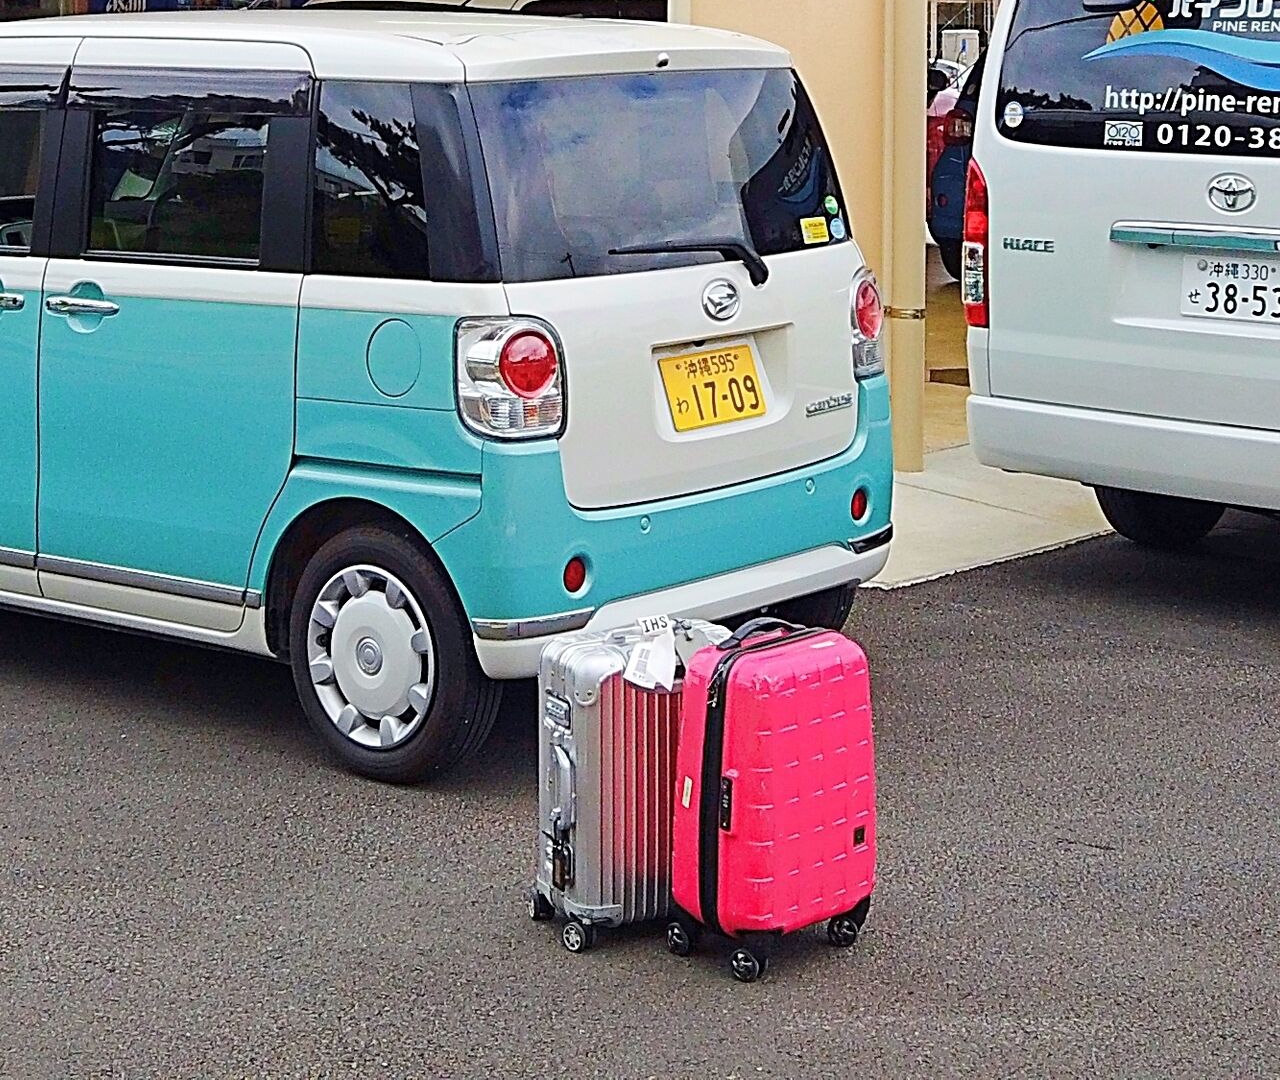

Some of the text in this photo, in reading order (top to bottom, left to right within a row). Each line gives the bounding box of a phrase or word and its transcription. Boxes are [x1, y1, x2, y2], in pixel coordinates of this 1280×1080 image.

[1212, 20, 1247, 32] PINE
[1188, 289, 1201, 304] せ
[676, 375, 760, 421] わ 17-09
